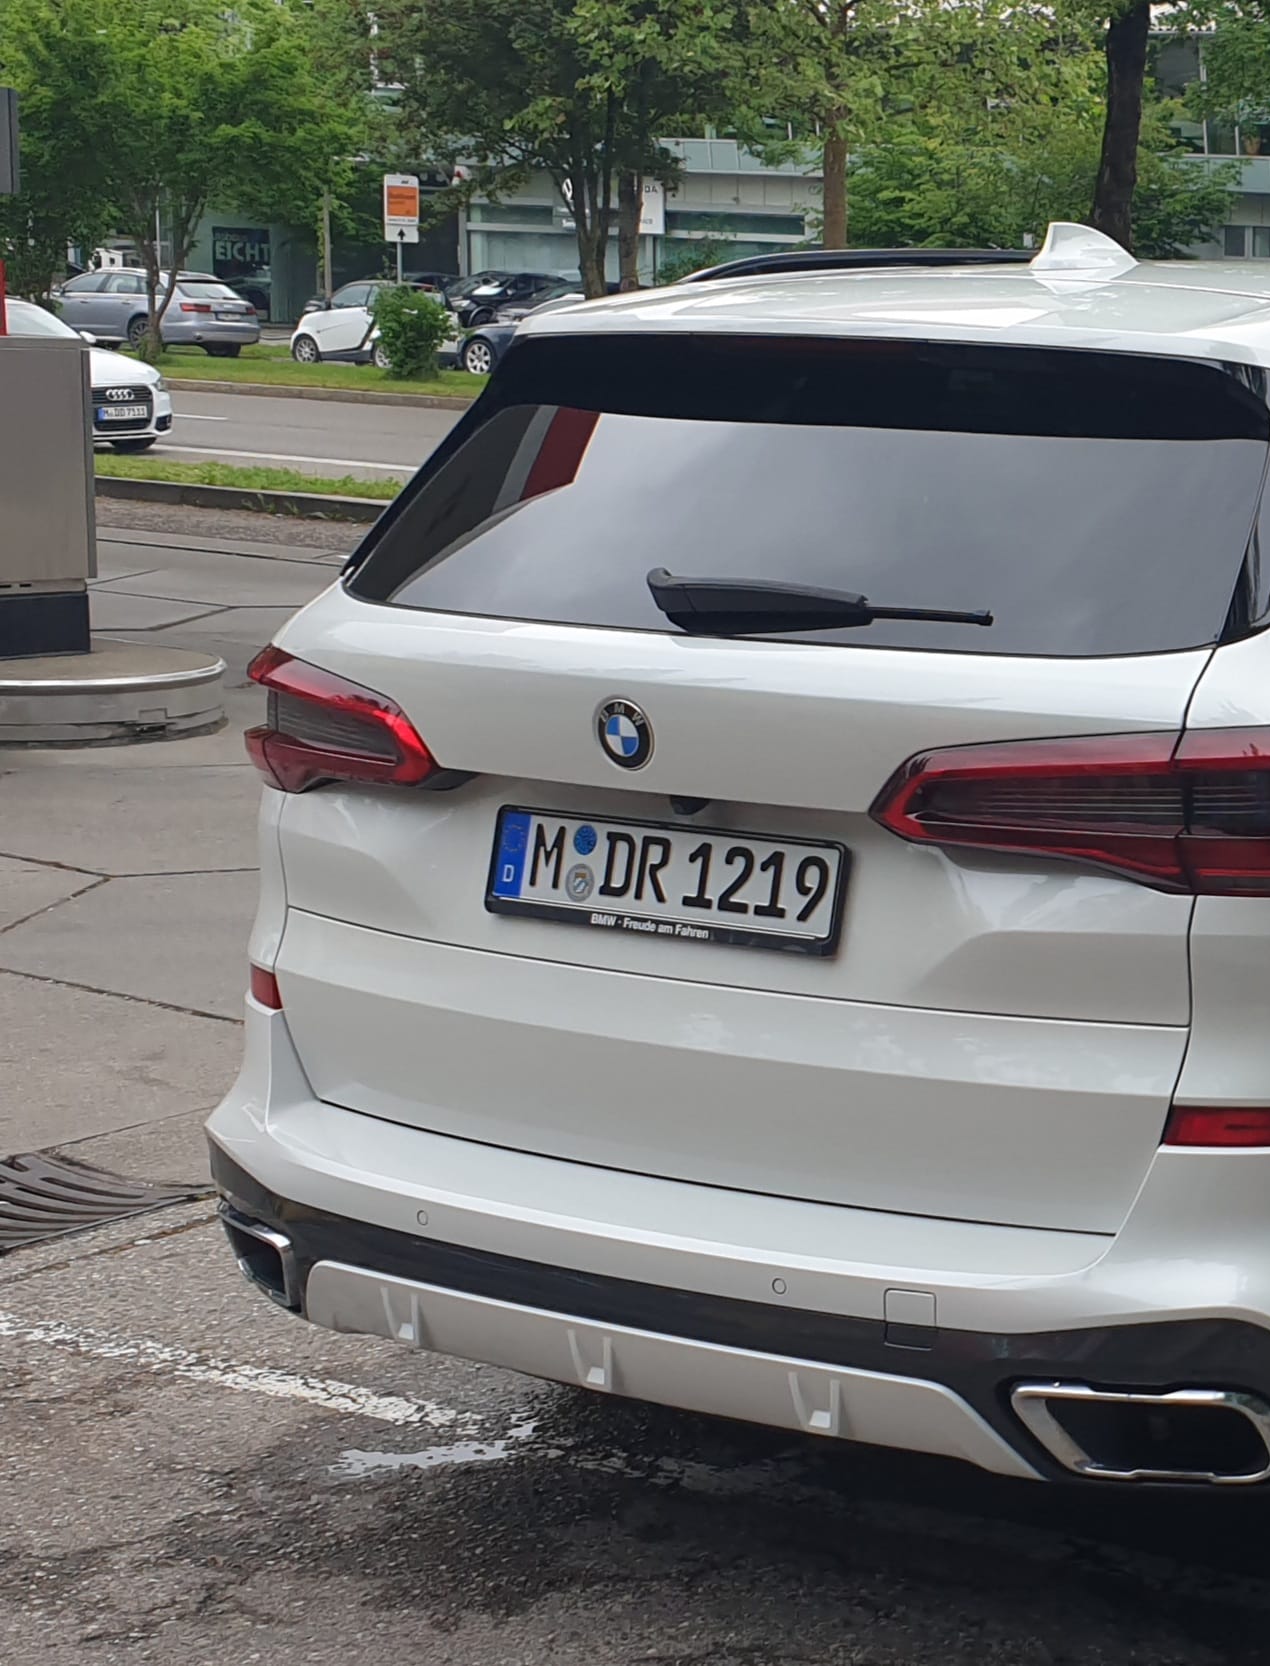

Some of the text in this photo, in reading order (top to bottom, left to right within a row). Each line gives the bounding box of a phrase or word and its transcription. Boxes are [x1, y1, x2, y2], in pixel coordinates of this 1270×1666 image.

[502, 864, 514, 882] D
[528, 823, 829, 922] M DR 1219
[590, 912, 617, 927] BMW
[622, 917, 656, 932] Freude
[657, 924, 673, 934] am
[674, 924, 709, 939] Fahren
